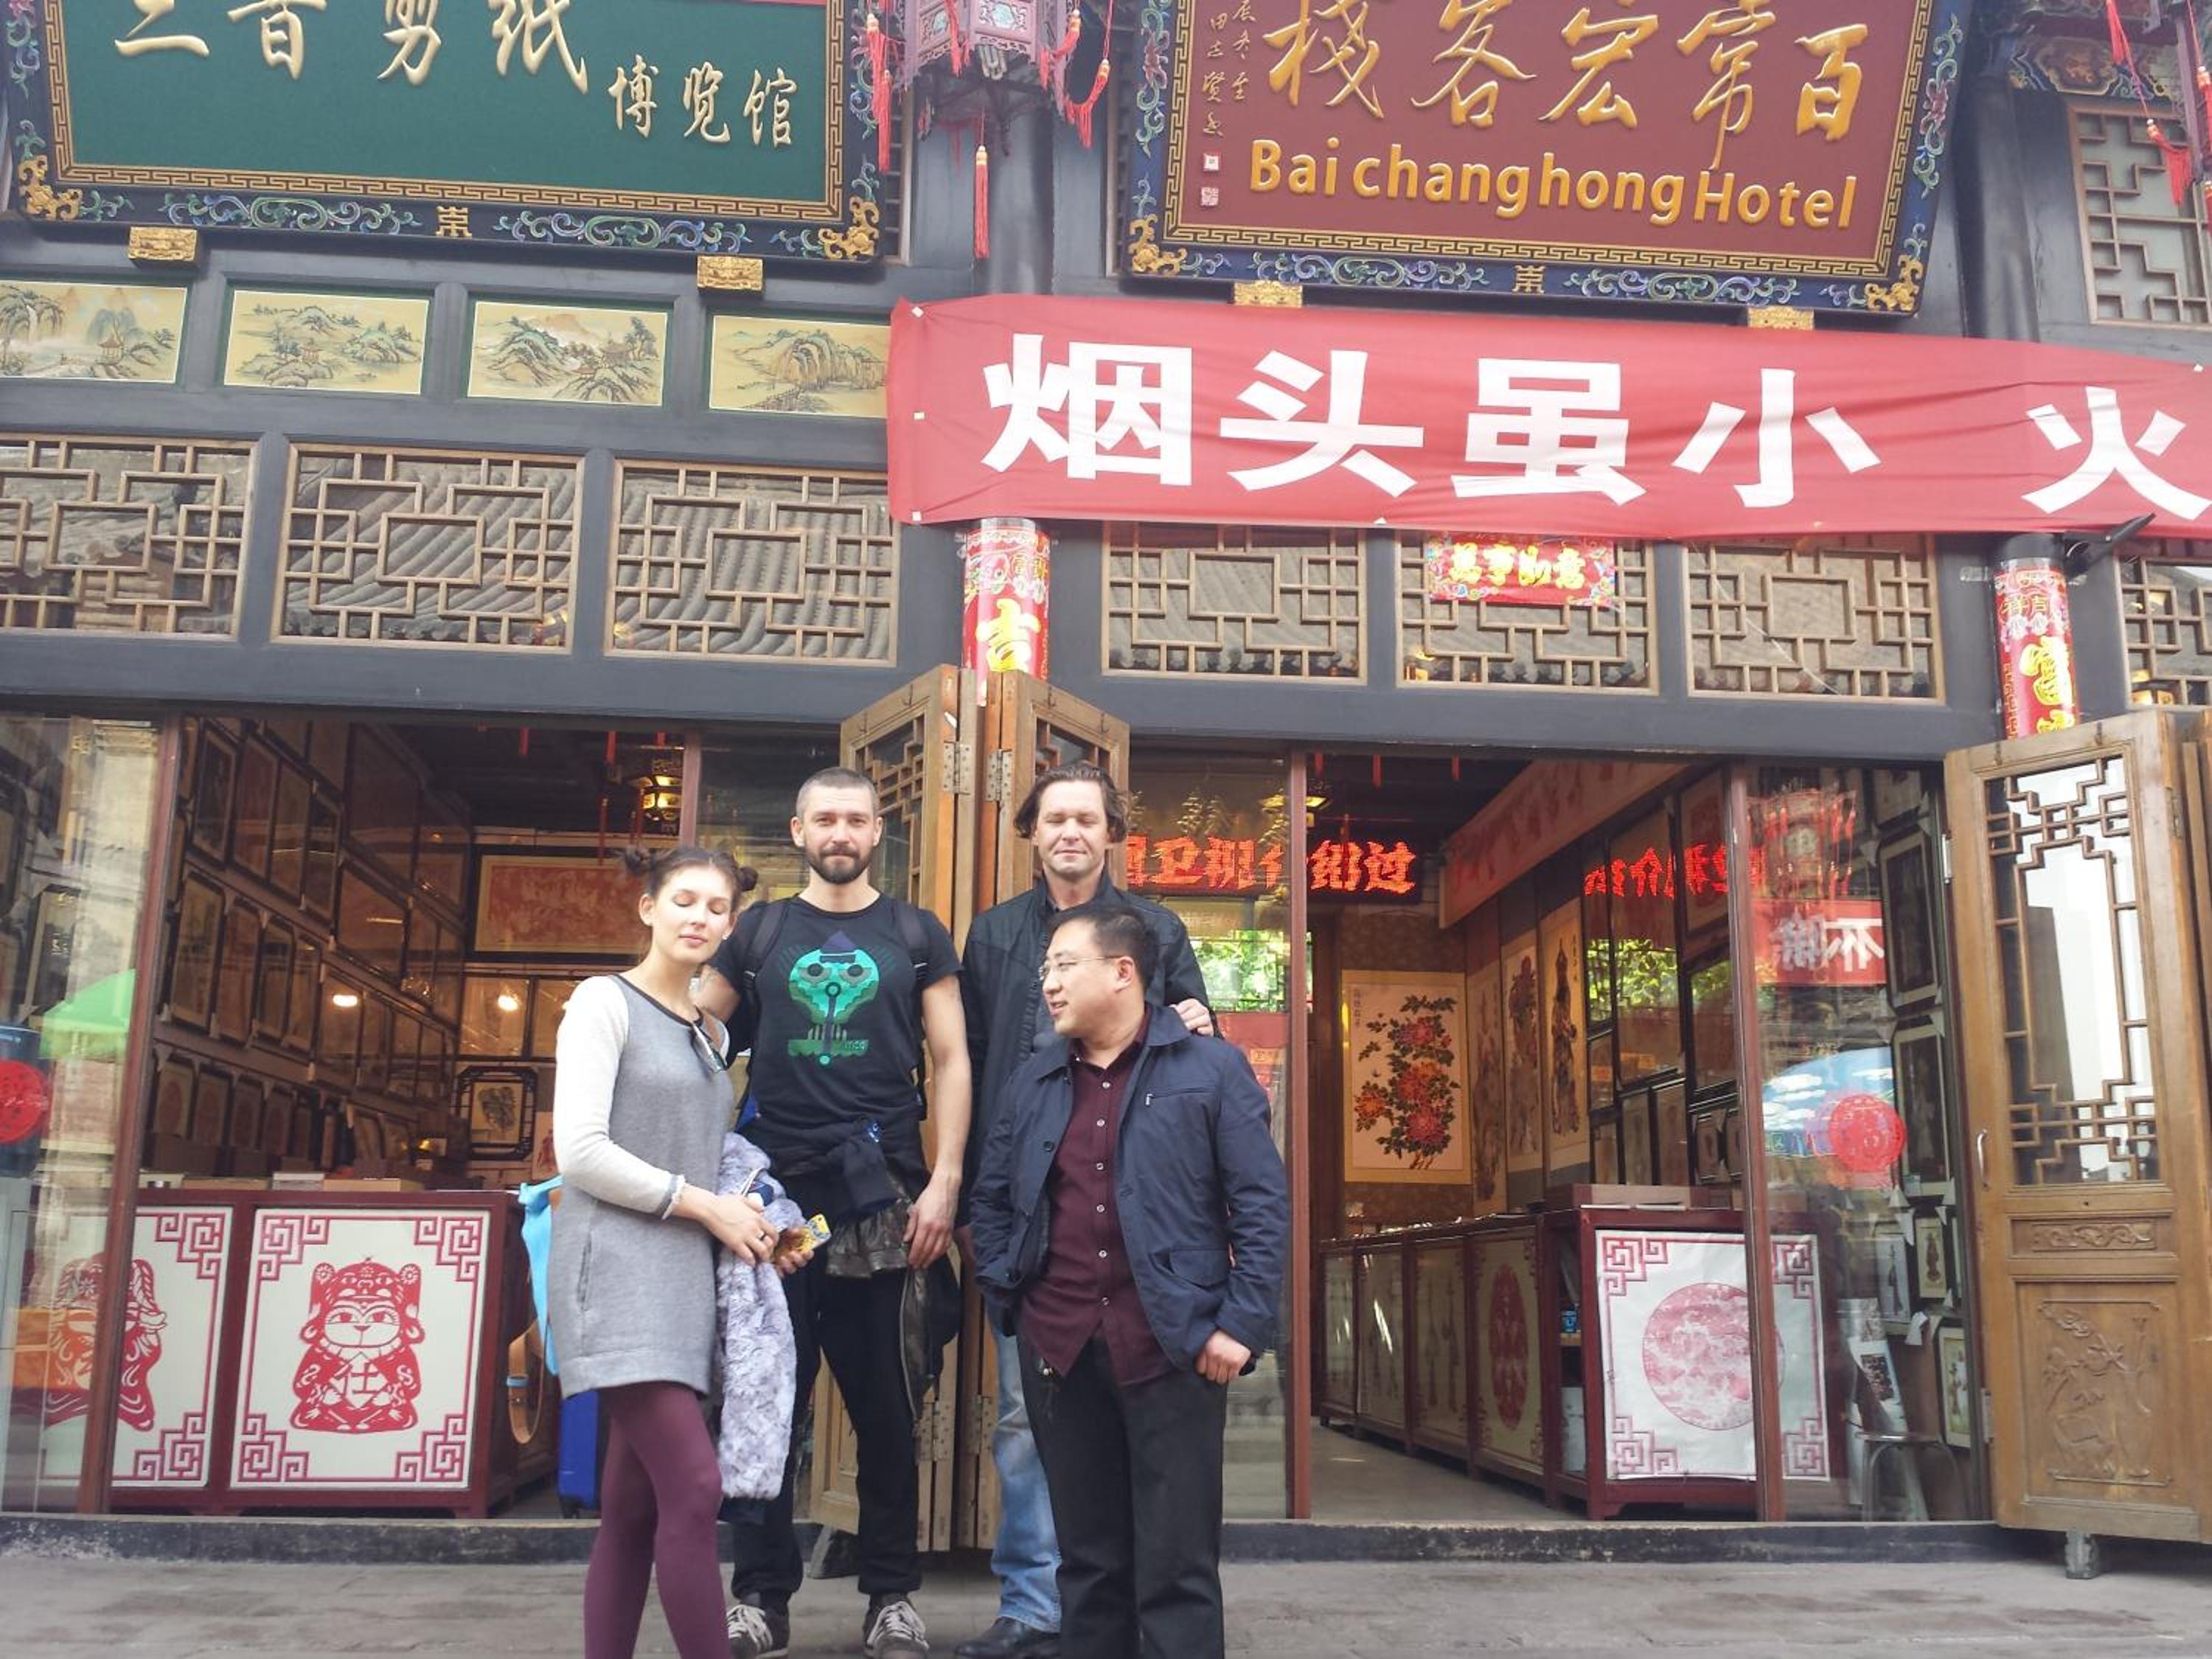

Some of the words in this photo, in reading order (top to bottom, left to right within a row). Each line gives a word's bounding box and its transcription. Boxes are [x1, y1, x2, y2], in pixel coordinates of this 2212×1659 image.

[608, 55, 797, 147] 博览馆
[1693, 170, 1857, 228] Hotel
[334, 1362, 380, 1397] 仕
